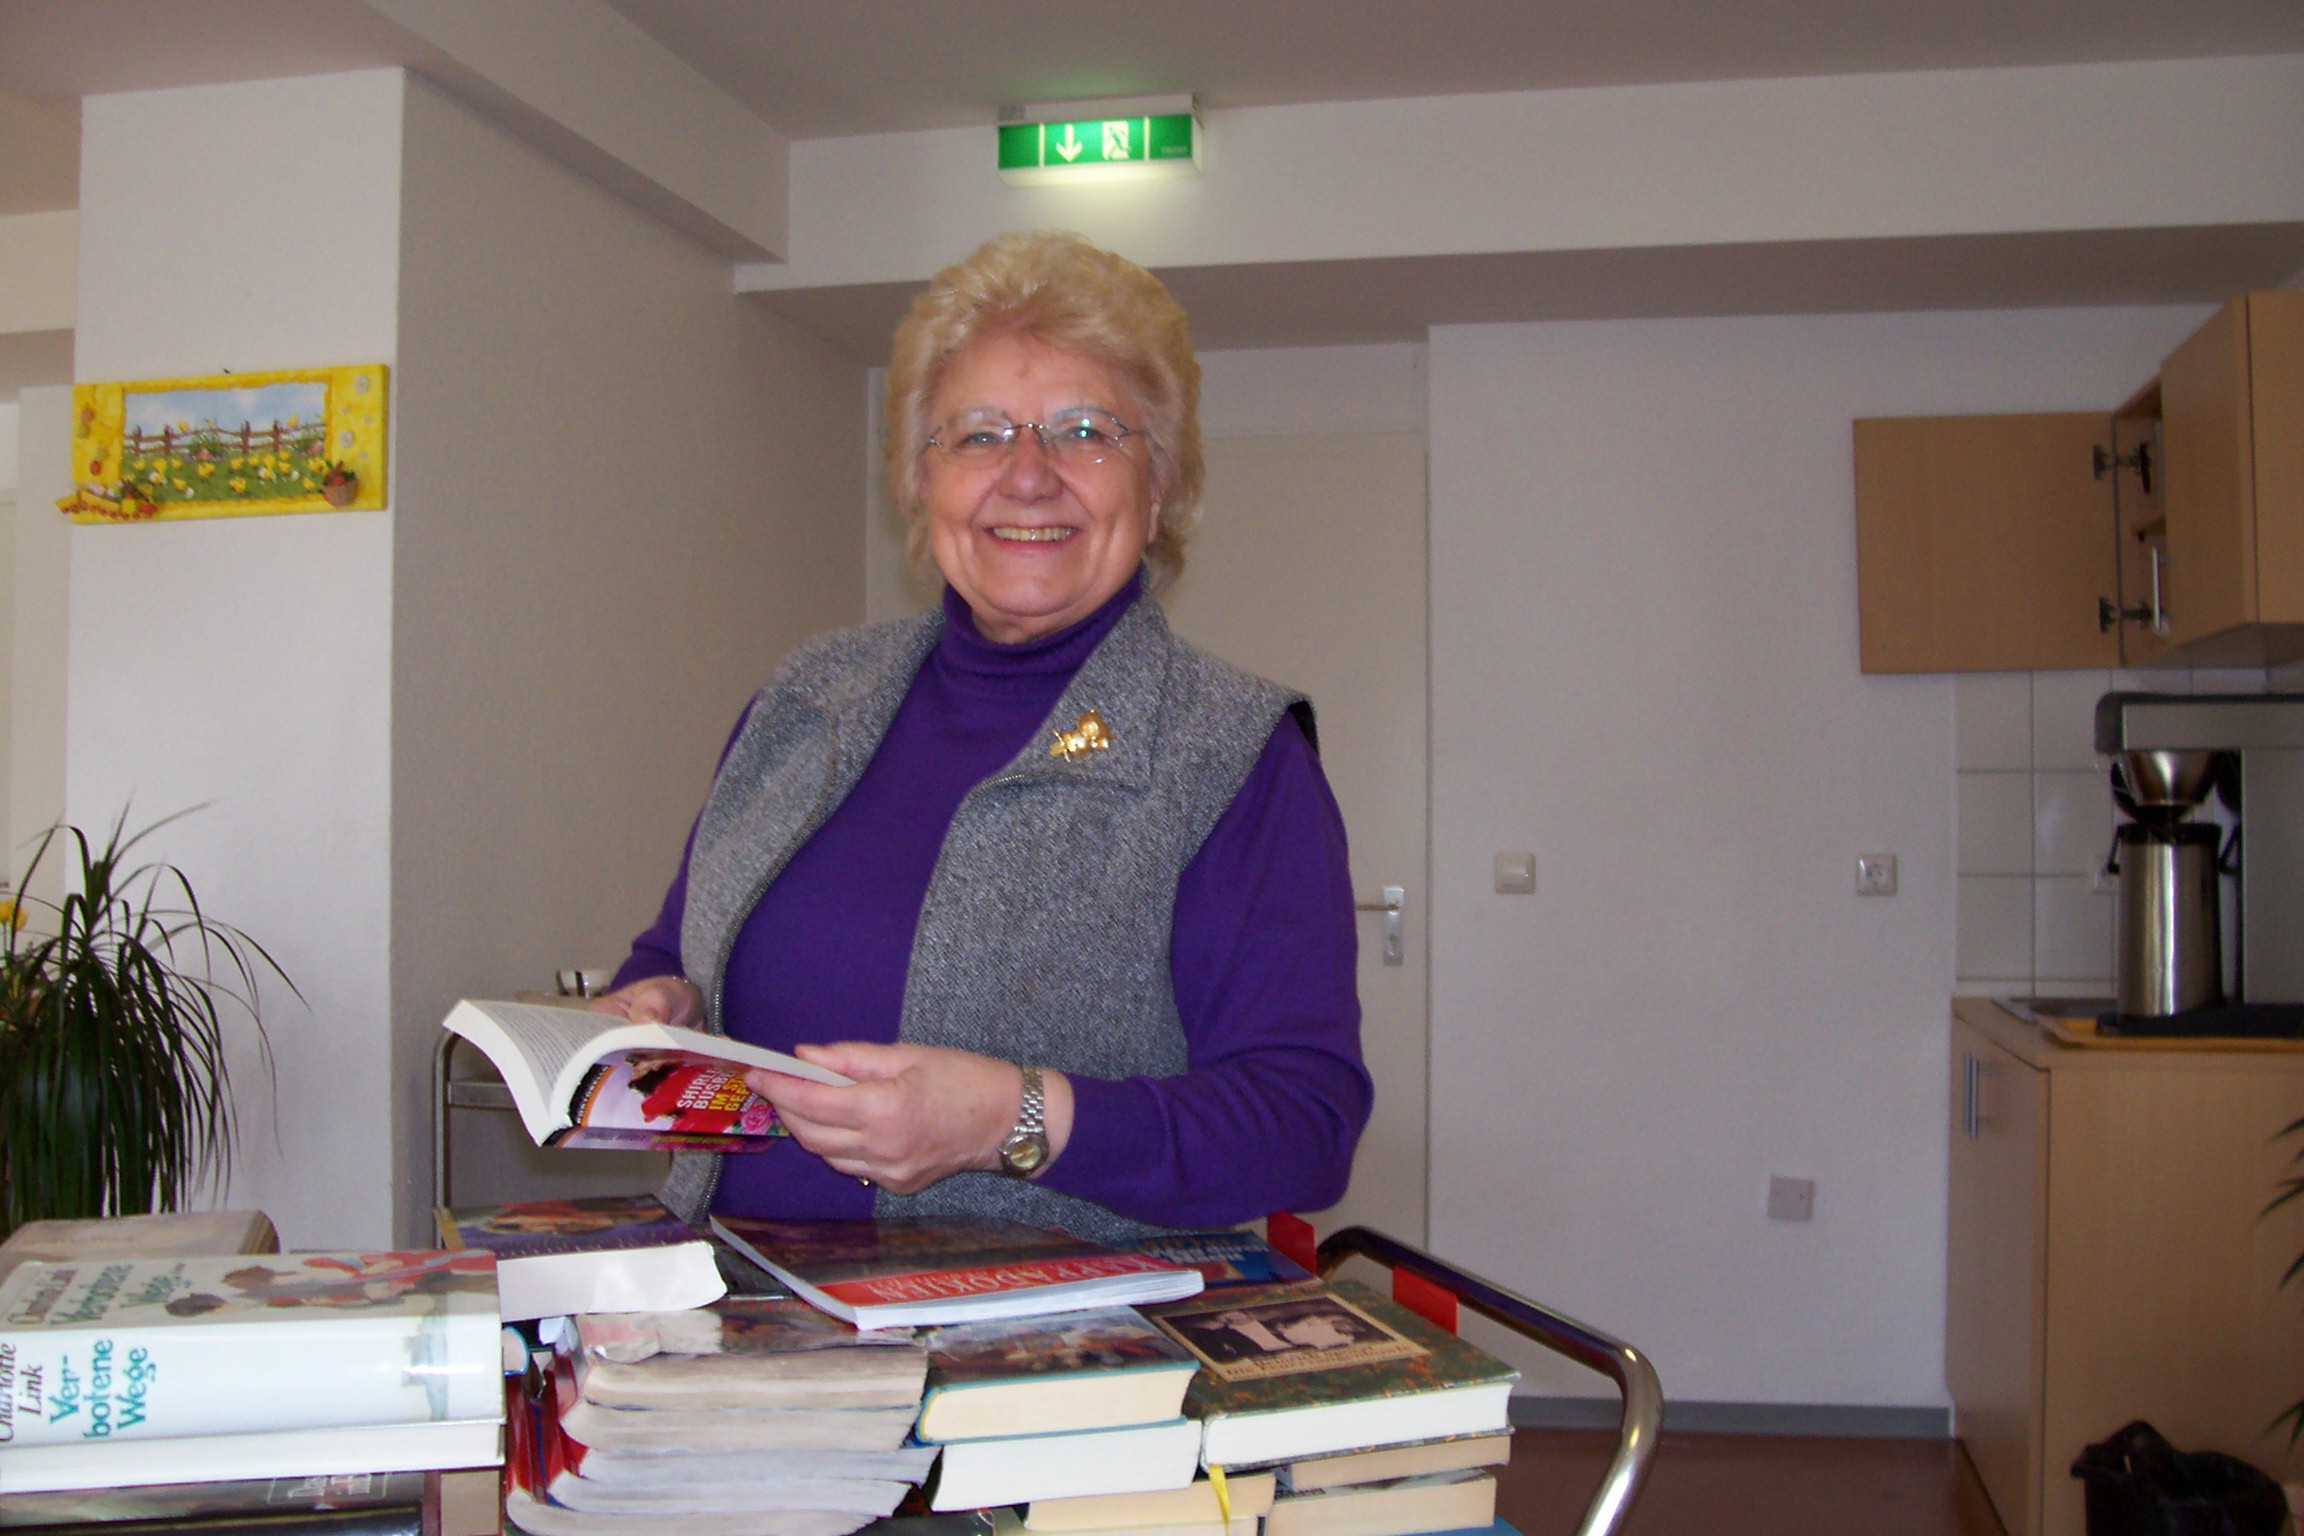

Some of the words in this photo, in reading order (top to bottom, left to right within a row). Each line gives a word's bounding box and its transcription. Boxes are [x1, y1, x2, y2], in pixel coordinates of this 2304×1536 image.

[708, 1093, 730, 1110] IM
[18, 1362, 43, 1417] Link
[48, 1354, 80, 1424] Ver-
[83, 1338, 113, 1438] botene
[115, 1347, 156, 1430] Wege
